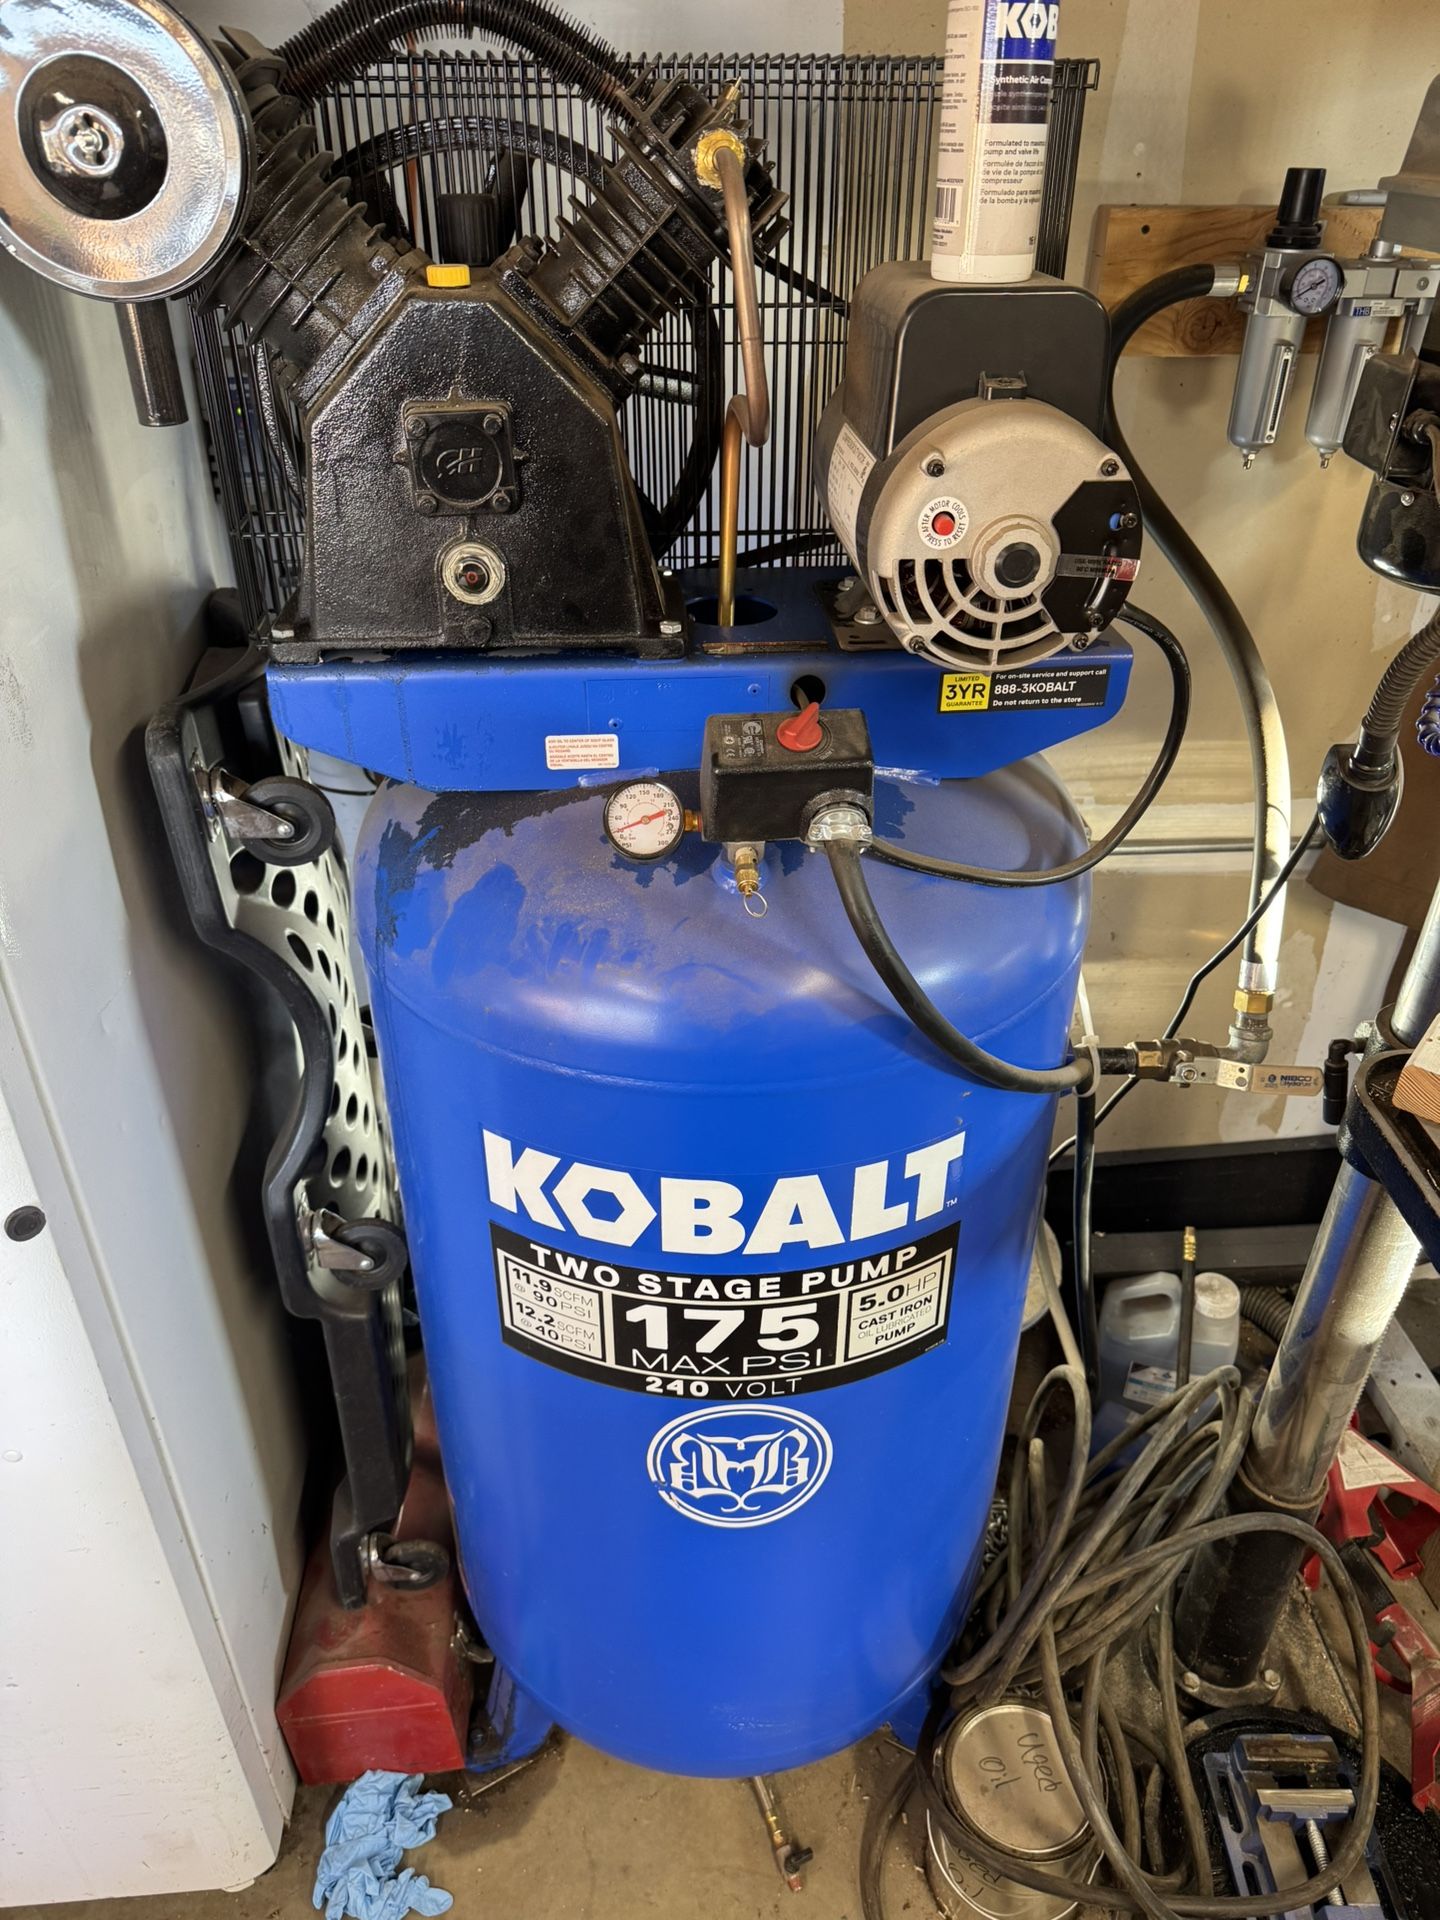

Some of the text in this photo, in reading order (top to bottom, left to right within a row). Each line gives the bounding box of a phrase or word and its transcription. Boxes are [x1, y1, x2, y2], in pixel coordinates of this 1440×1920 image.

[1030, 75, 1039, 84] Air
[984, 139, 1022, 147] Formulated
[984, 149, 1003, 157] pump
[921, 499, 966, 533] AFTER MOTOR COOLS
[925, 522, 967, 547] PRESS TO RESET
[955, 675, 980, 683] LIMITED
[1069, 669, 1094, 677] support
[945, 683, 986, 700] 3YR
[994, 681, 1077, 695] 888-3KOBALT
[945, 700, 983, 708] GUARANTEE
[483, 1128, 966, 1255] KOBALT
[530, 1243, 917, 1300] TWO STAGE PUMP
[512, 1267, 593, 1308] 11.9 SCFM
[859, 1271, 937, 1312] 5.0 HP
[533, 1290, 558, 1308] 90
[560, 1301, 591, 1319] PSI
[858, 1294, 933, 1330] CAST IRON
[516, 1301, 595, 1341] 12.2 SCFM
[626, 1302, 820, 1354] 175
[858, 1305, 932, 1340] OIL LUBRICATED
[875, 1322, 916, 1345] PUMP
[535, 1325, 559, 1341] 40
[561, 1335, 592, 1352] PSI
[632, 1348, 822, 1375] MAX PSI
[646, 1376, 802, 1398] 240 VOLT
[978, 1756, 1021, 1789] Oil
